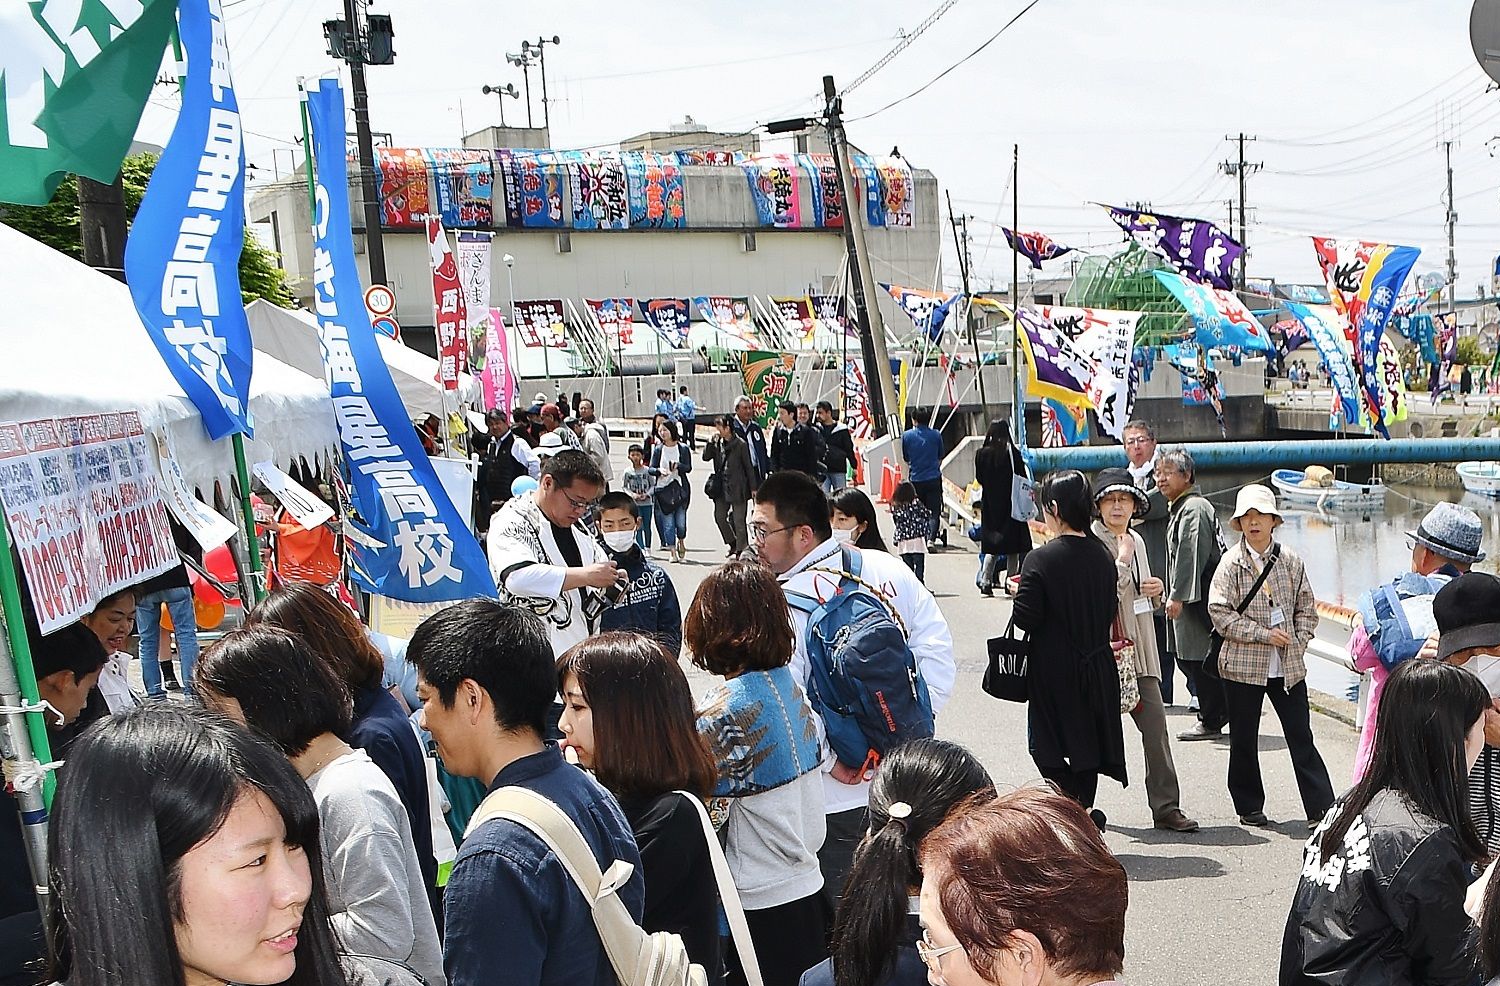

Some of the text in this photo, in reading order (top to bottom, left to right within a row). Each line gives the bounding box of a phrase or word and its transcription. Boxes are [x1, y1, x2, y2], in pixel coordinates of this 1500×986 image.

[161, 0, 240, 418] 星高校
[372, 293, 388, 307] 30
[470, 252, 486, 306] さんま
[440, 288, 458, 382] 西野屋
[21, 537, 75, 624] 100円
[875, 690, 897, 733] patagonia
